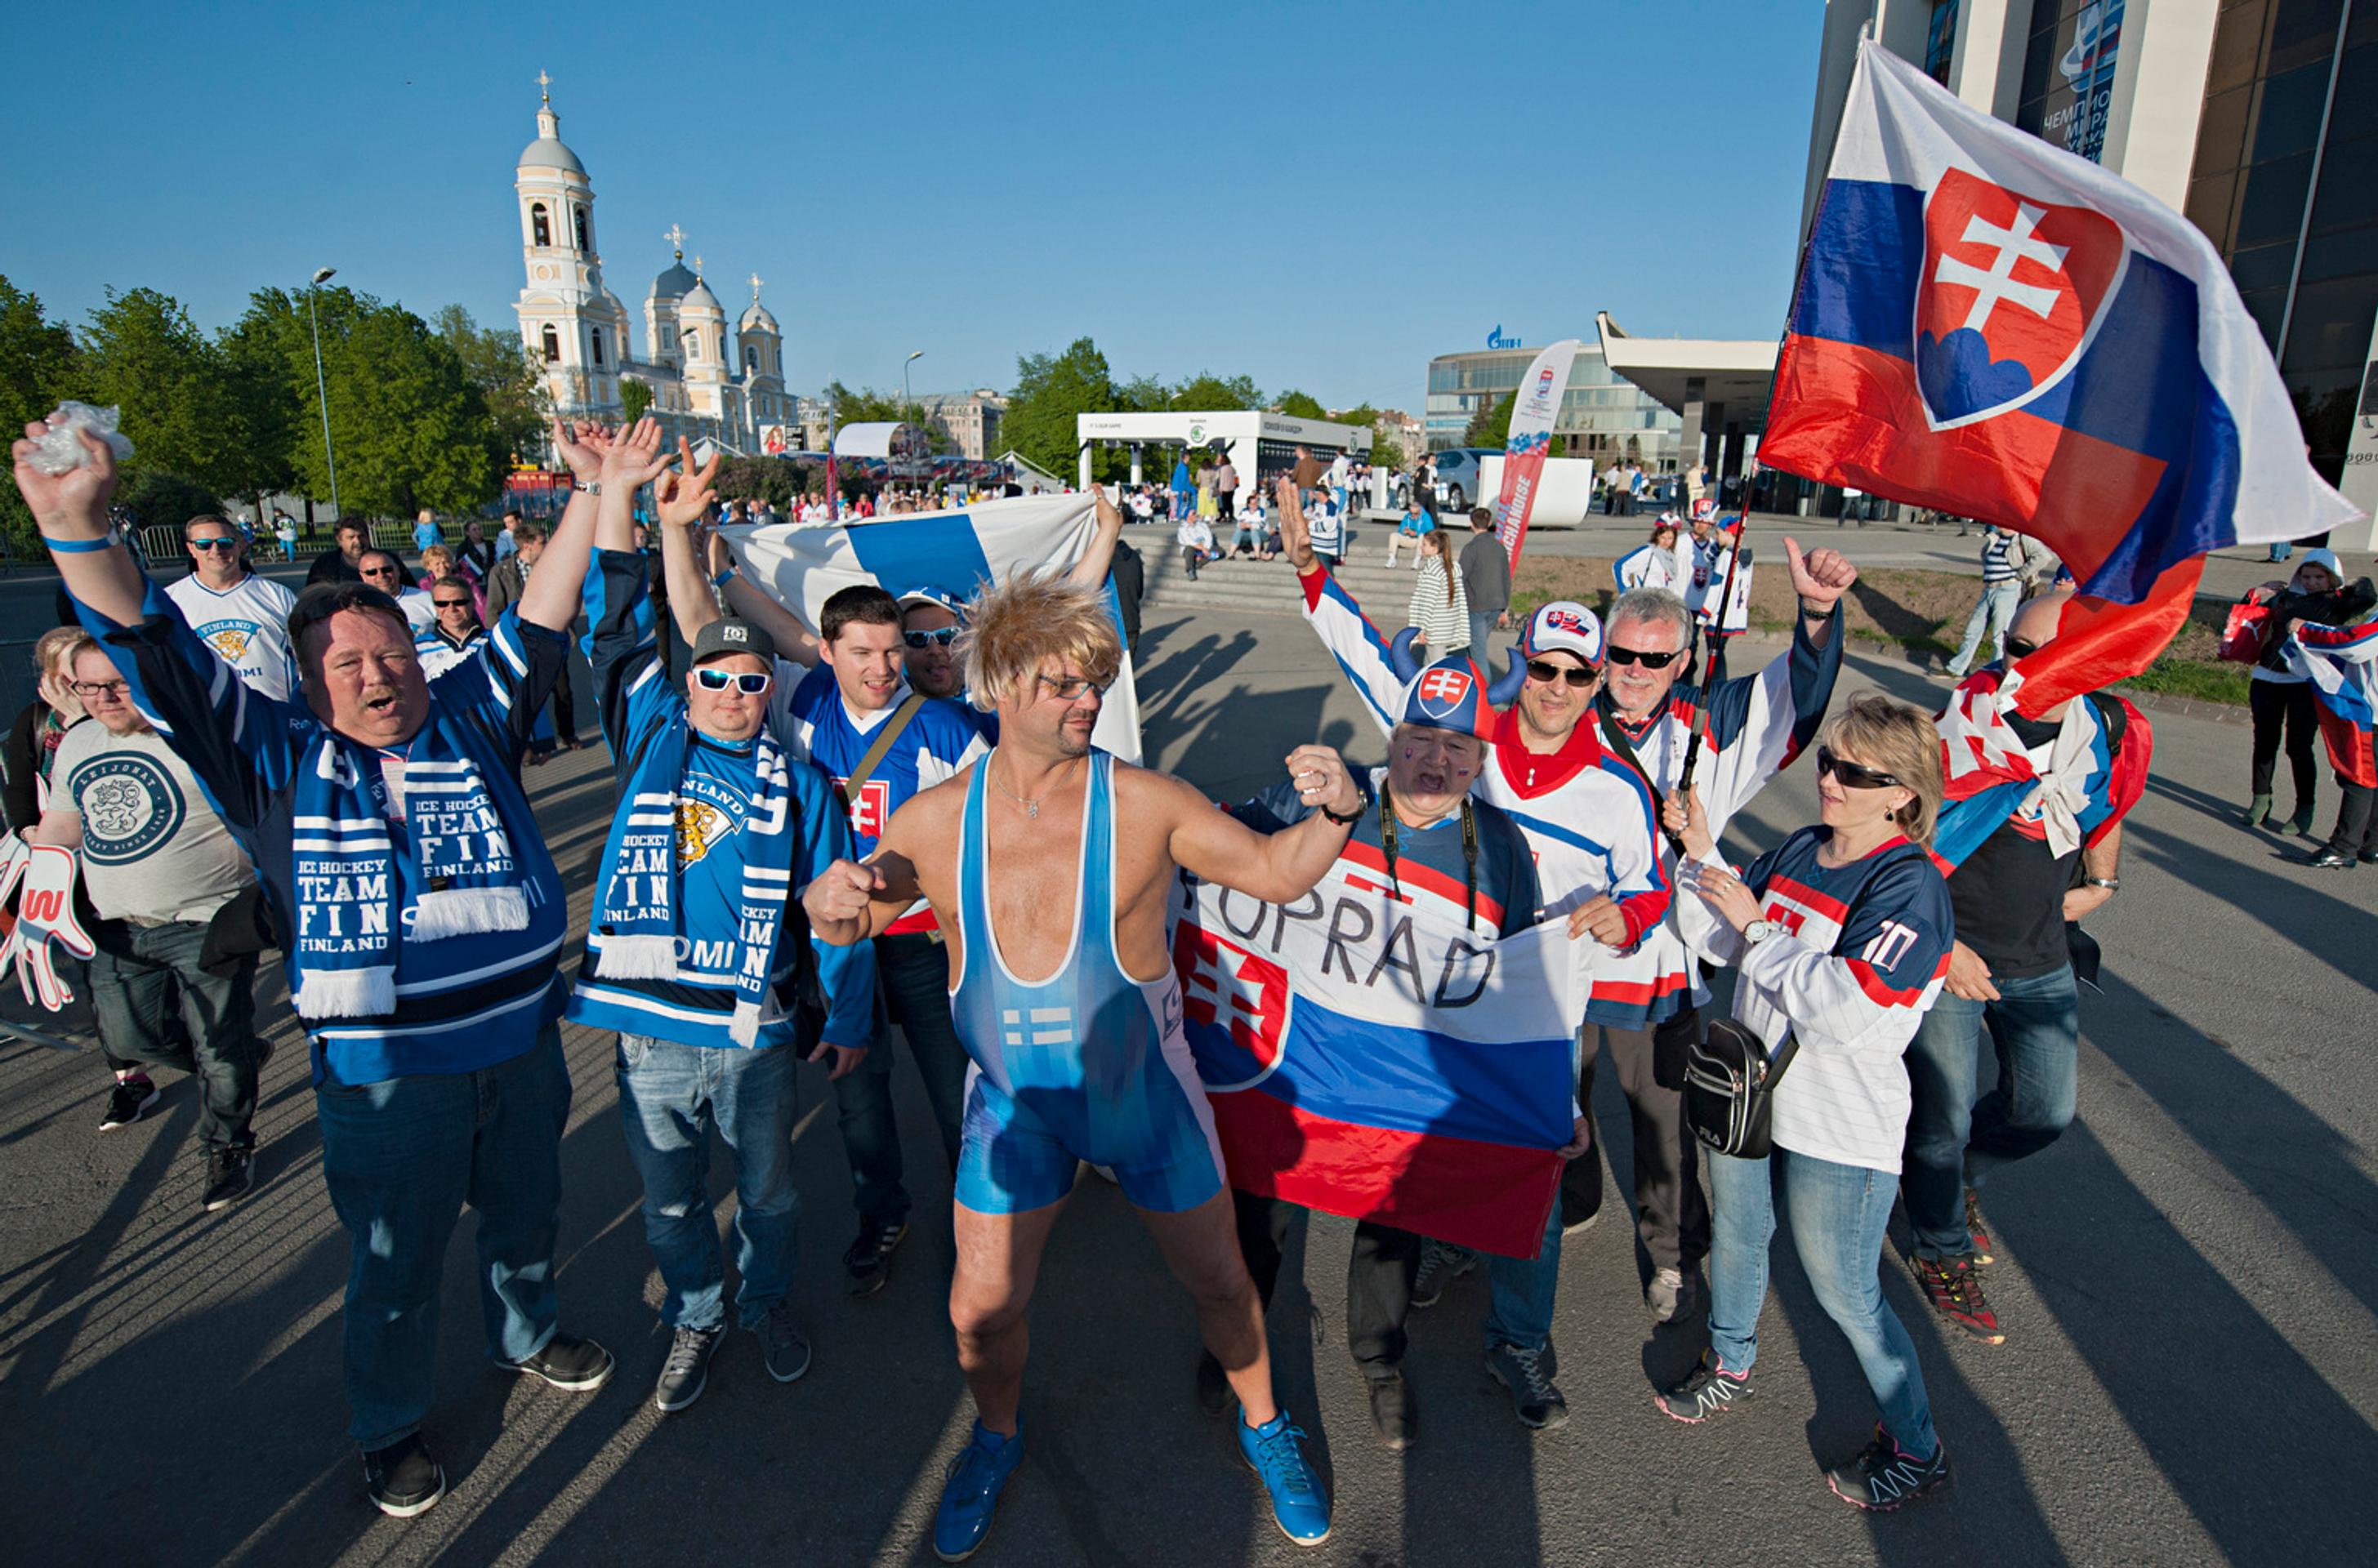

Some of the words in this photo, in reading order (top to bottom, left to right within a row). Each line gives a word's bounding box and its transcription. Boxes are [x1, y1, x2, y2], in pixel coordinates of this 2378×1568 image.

[200, 621, 252, 635] FINLAND
[80, 764, 156, 786] LEIJONAT
[415, 800, 439, 812] ICE
[681, 778, 744, 815] NLAND
[298, 861, 317, 874] ICE
[319, 859, 387, 874] HOCKEY
[423, 860, 514, 878] FINLAND
[298, 874, 388, 902] TEAM
[300, 936, 388, 953] FINLAND
[1861, 919, 1919, 973] 10
[1699, 1125, 1721, 1147] FILA
